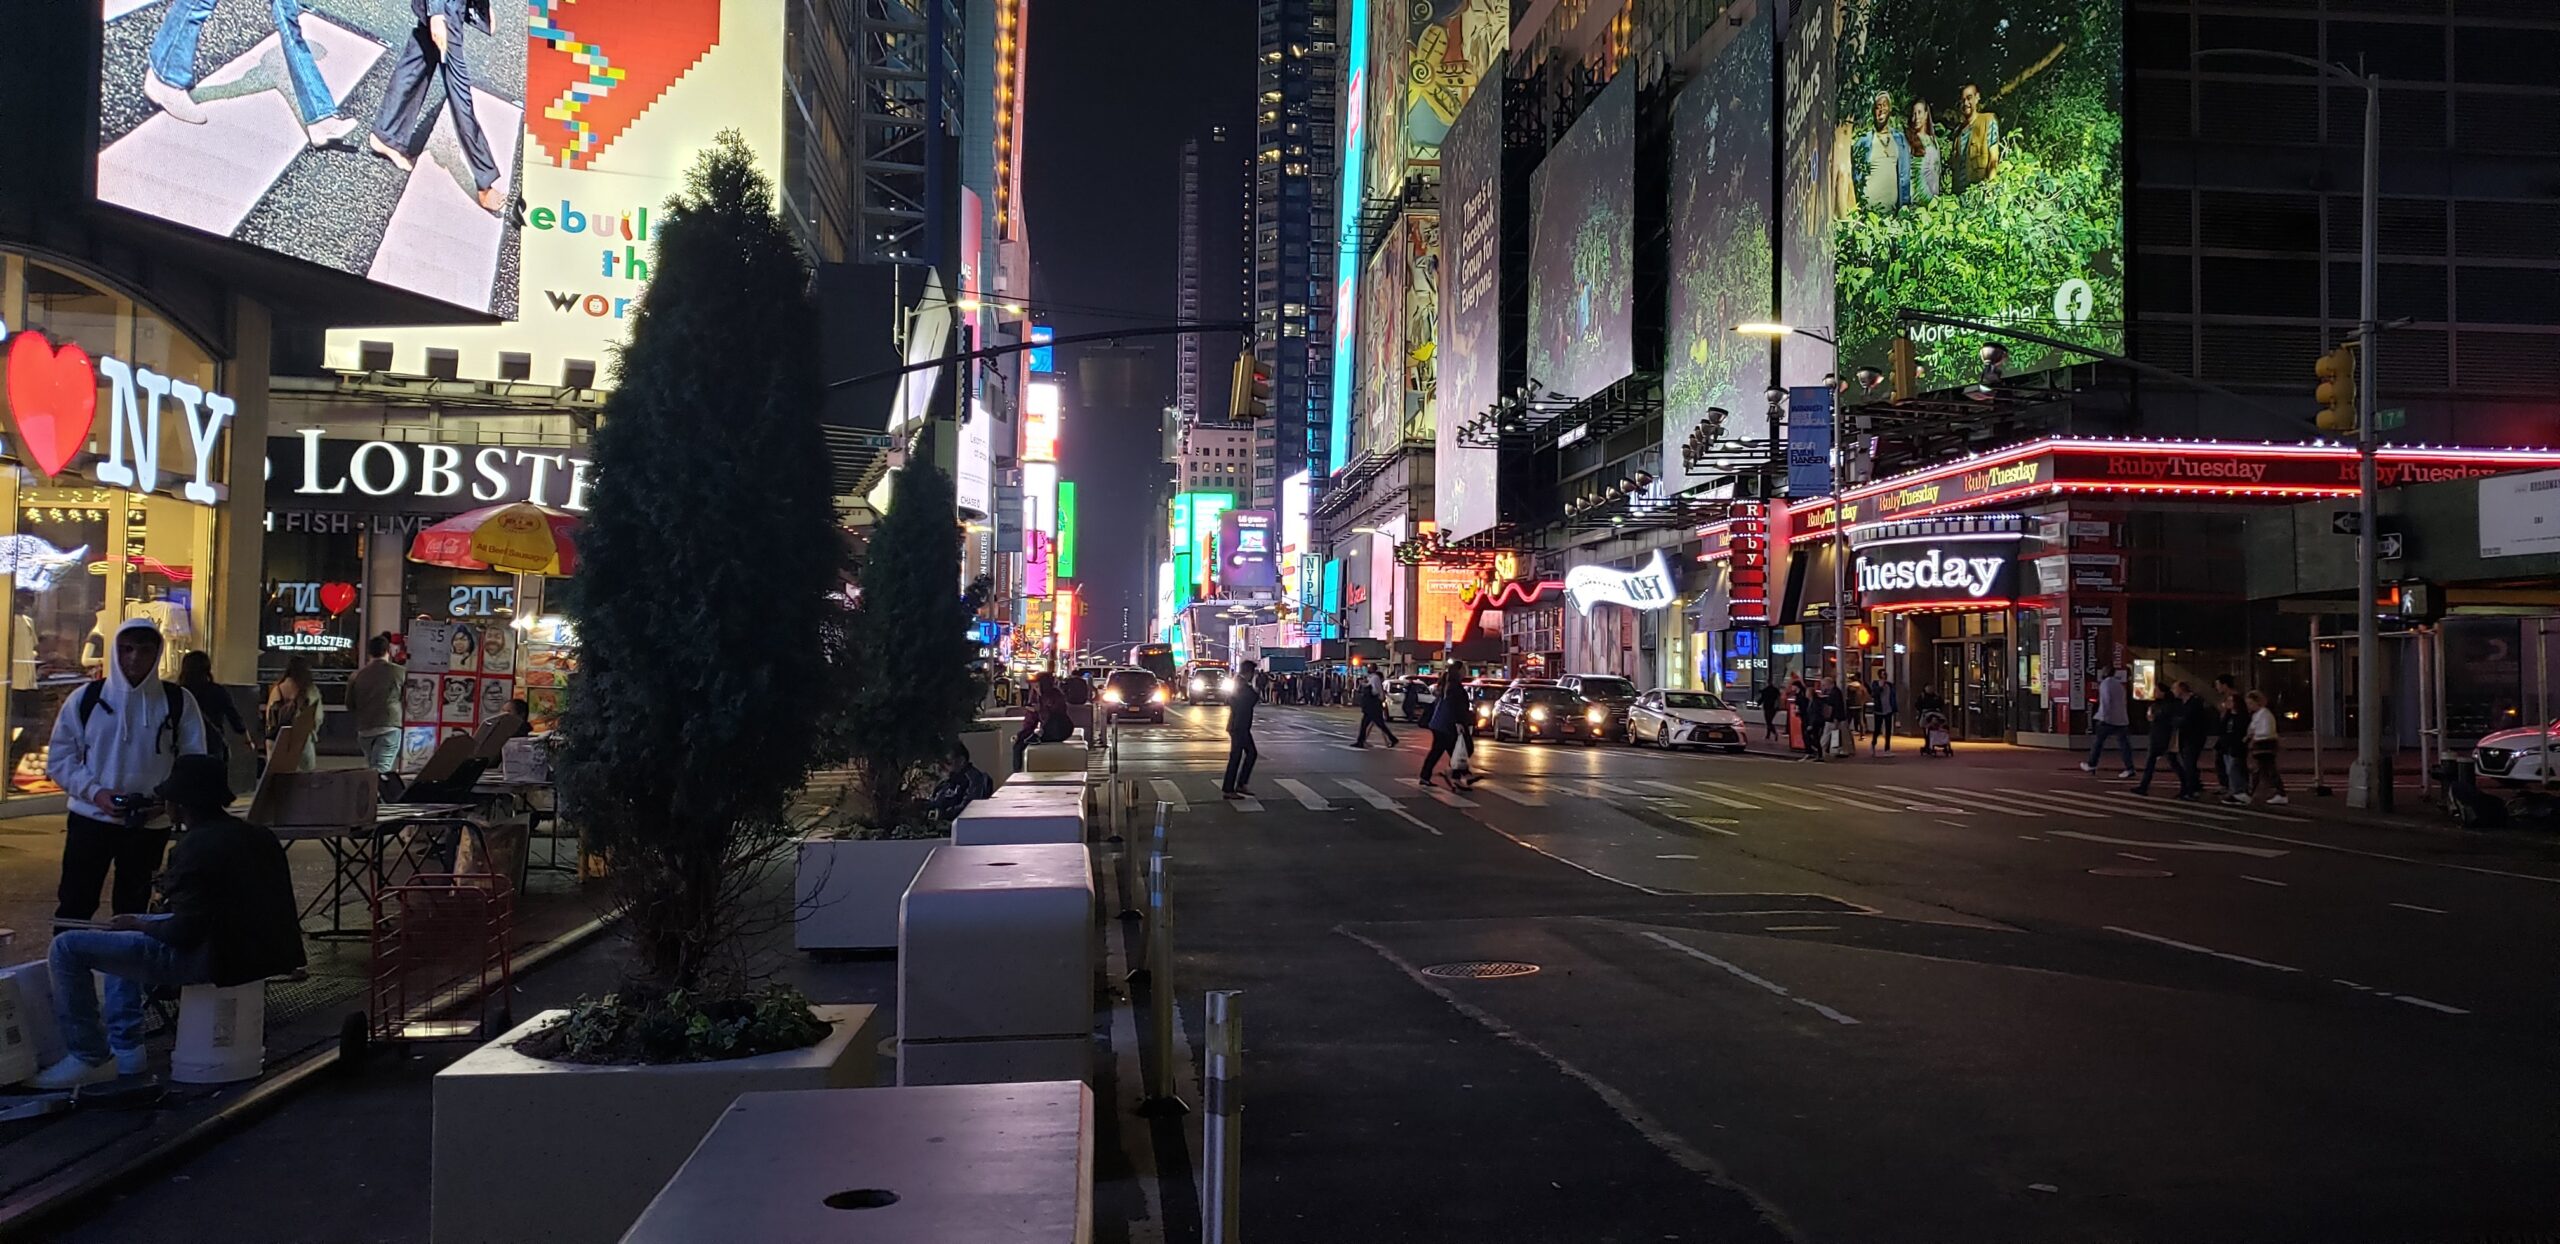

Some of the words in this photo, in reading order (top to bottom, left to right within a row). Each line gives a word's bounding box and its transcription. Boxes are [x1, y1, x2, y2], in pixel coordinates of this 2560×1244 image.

[1786, 49, 1800, 102] Big
[1801, 5, 1822, 68] Tree
[1785, 61, 1821, 150] Seekers
[513, 199, 651, 241] Rebuil
[1463, 179, 1487, 227] There's
[1487, 177, 1493, 198] a
[1462, 199, 1495, 256] Facebook
[602, 245, 649, 281] th
[1462, 249, 1482, 285] Group
[1483, 235, 1494, 263] for
[545, 290, 632, 319] wor
[1462, 268, 1492, 315] Everyone
[1910, 322, 1955, 343] More
[96, 356, 236, 505] NY
[1791, 449, 1814, 457] EVAN
[2107, 454, 2267, 483] RubyTuesday
[1964, 460, 2039, 492] RubyTuesday
[1879, 484, 1940, 513] RubyTuesday
[286, 512, 349, 534] FISH
[1746, 504, 1758, 565] Ruby
[476, 543, 487, 552] All
[489, 545, 508, 555] Beef
[980, 532, 988, 565] REUTERS
[1306, 557, 1314, 605] NYPD
[1856, 550, 2005, 597] Tuesday
[266, 634, 294, 647] RED
[296, 633, 353, 648] LOBSTER
[2086, 626, 2098, 676] Tuesday
